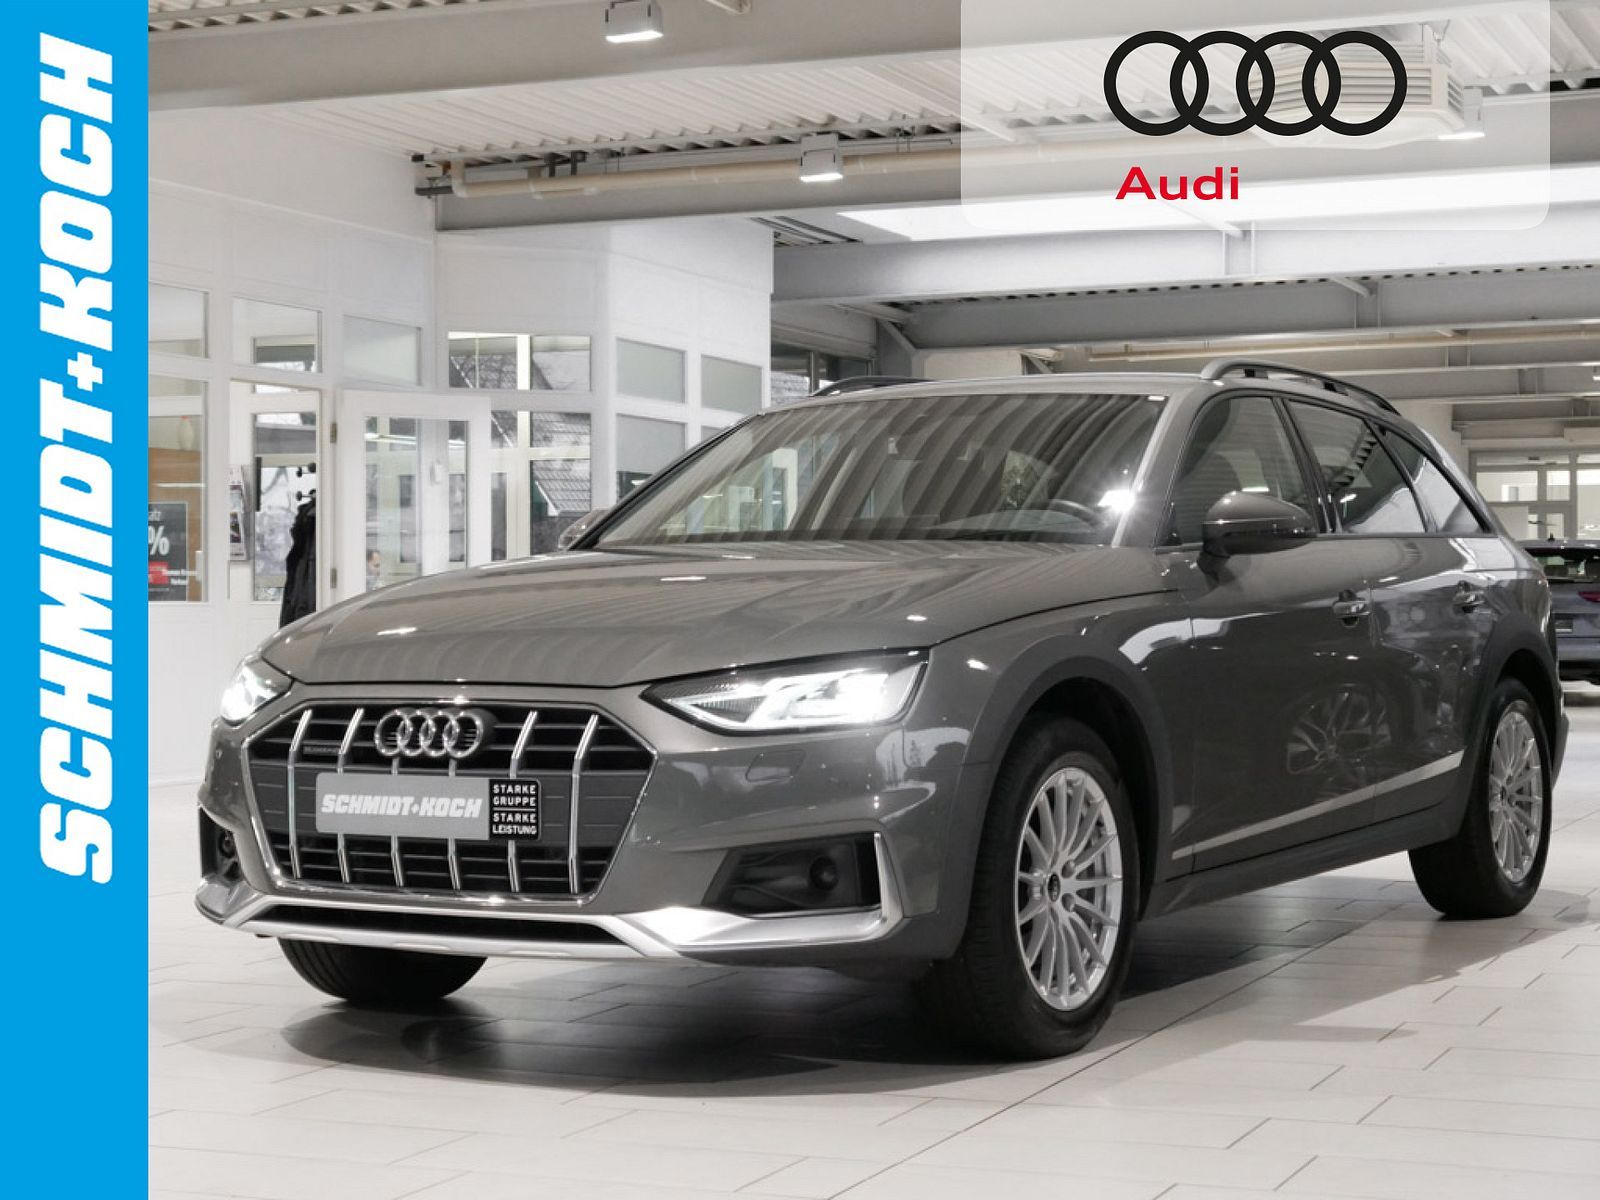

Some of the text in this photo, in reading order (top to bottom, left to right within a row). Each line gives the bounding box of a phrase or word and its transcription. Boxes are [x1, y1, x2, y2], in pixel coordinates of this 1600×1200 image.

[493, 784, 536, 794] STARKE
[493, 796, 536, 807] GRUPPE
[493, 813, 536, 823] STARKE
[492, 824, 537, 835] LEISTUNG
